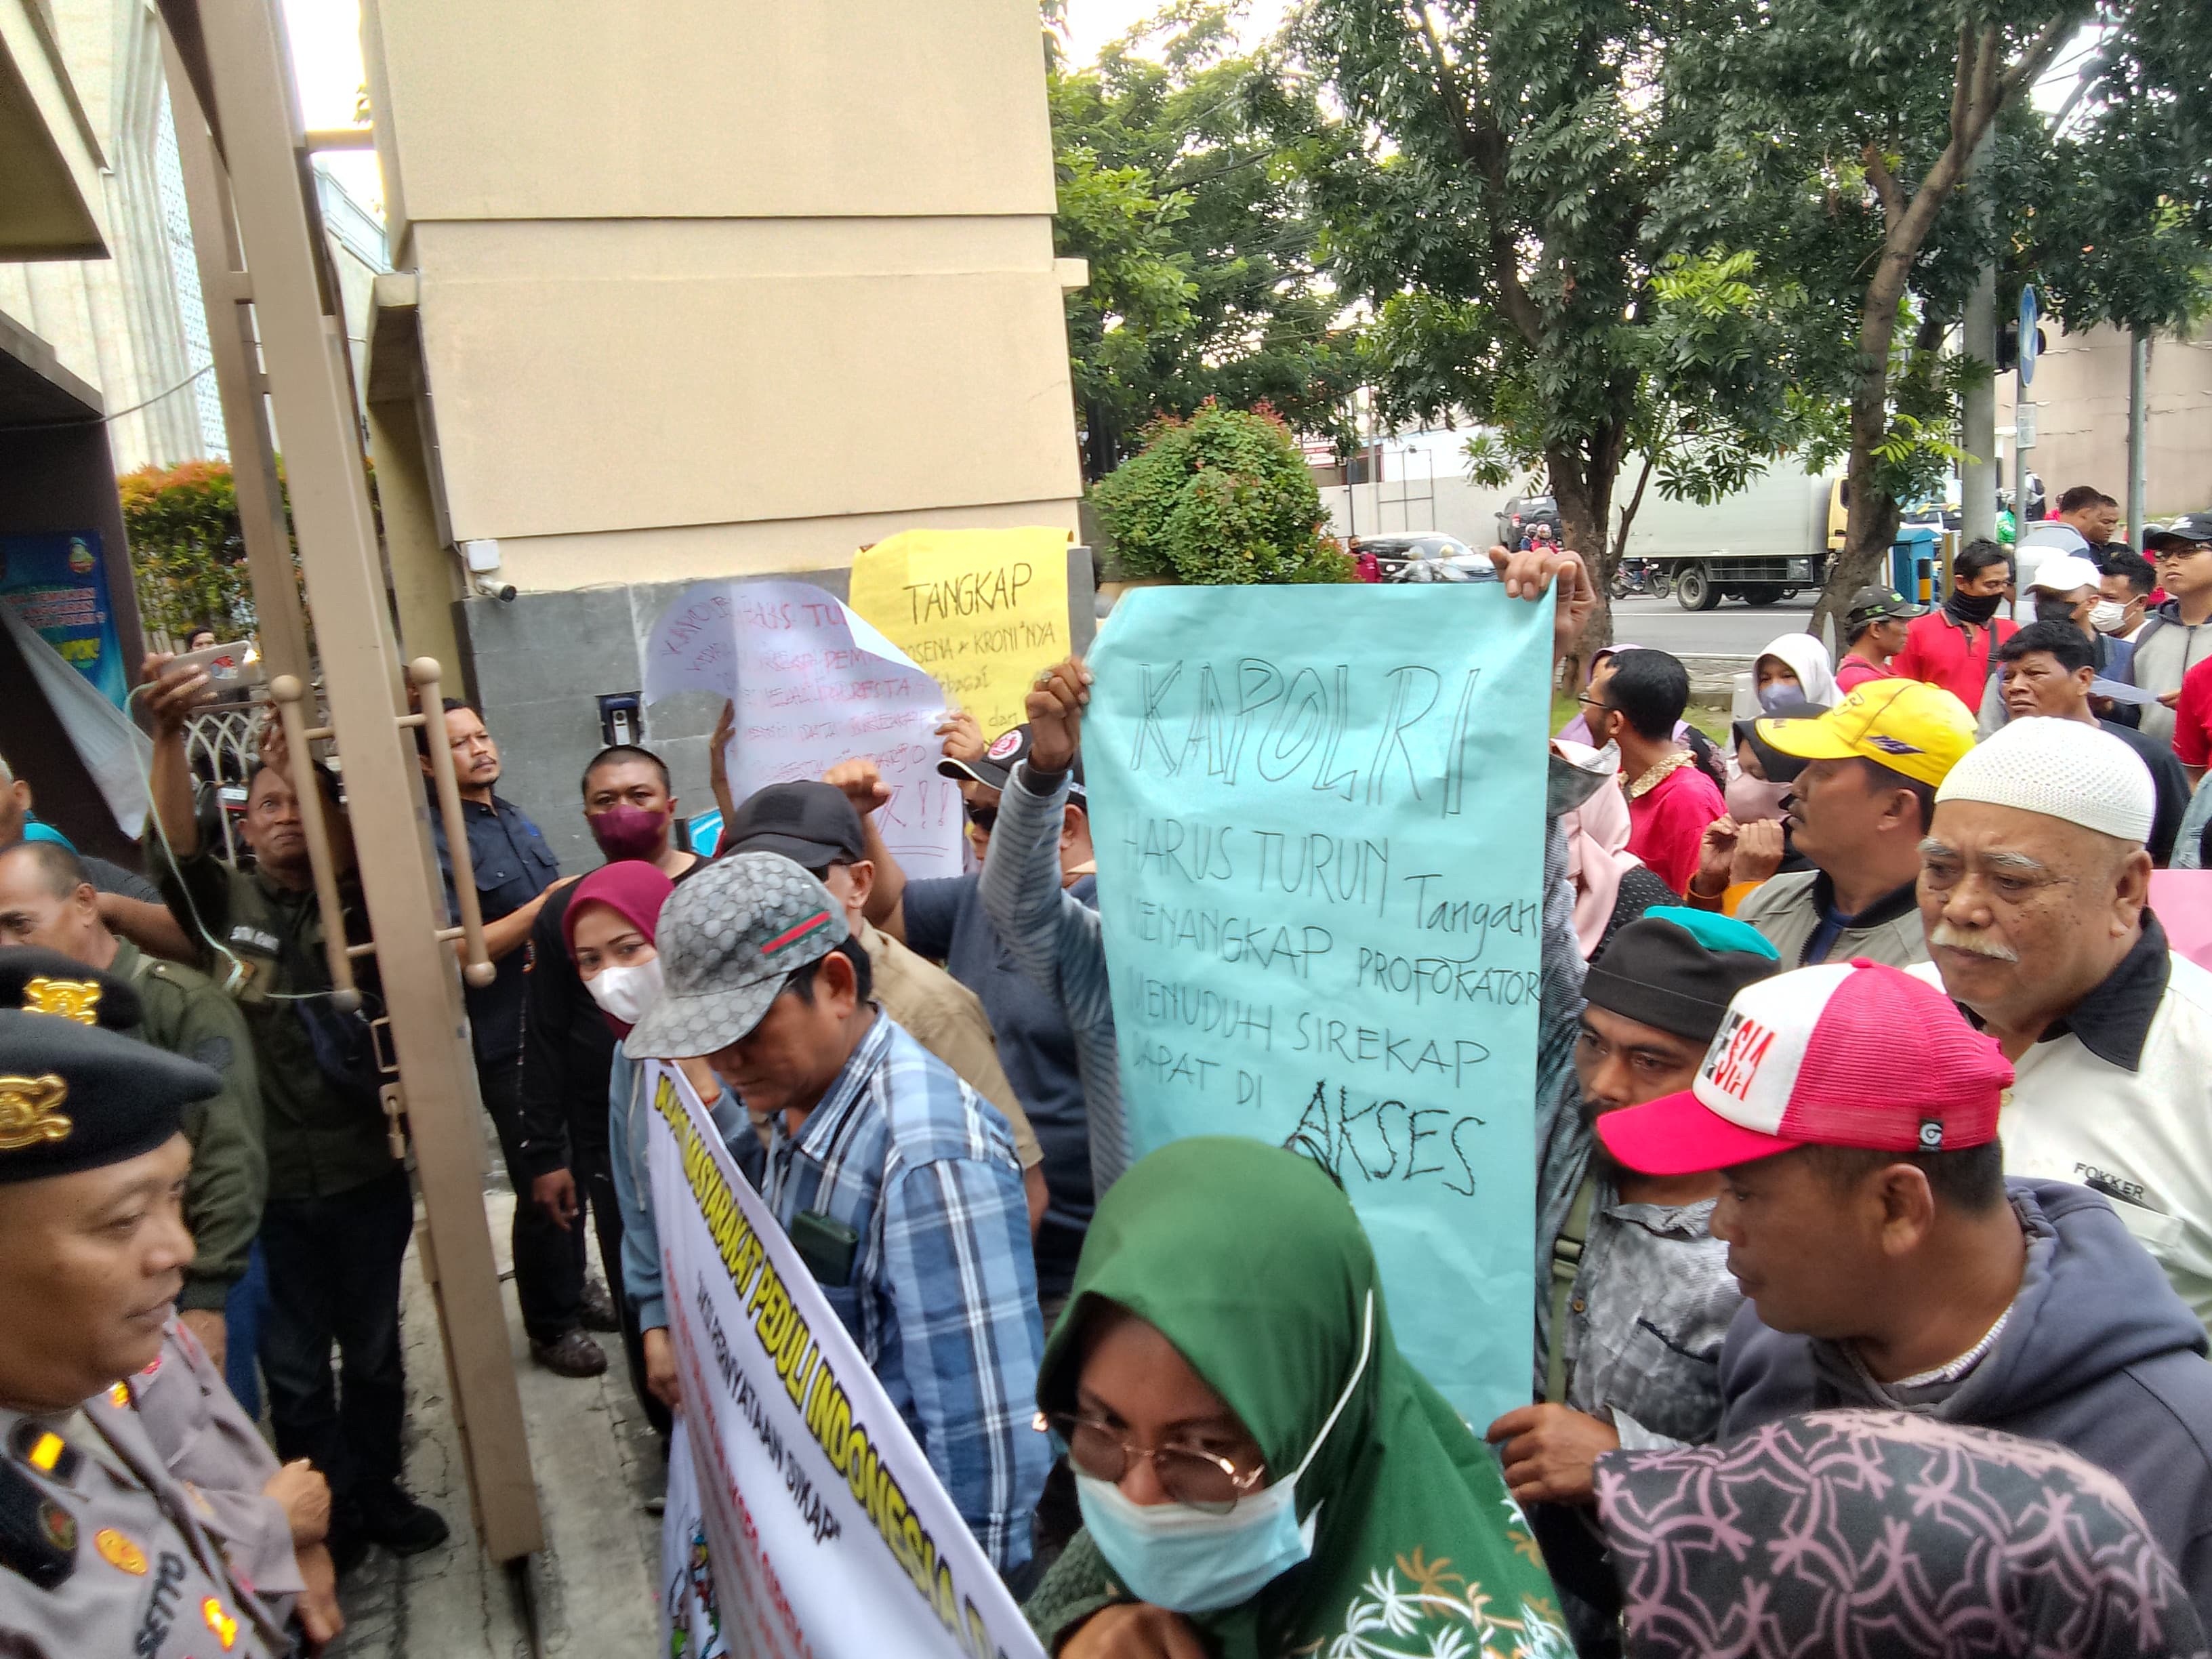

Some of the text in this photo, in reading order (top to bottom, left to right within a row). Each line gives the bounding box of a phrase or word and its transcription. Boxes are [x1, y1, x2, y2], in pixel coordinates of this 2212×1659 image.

[902, 562, 1033, 625] TANGKAP
[1130, 657, 1480, 818] KAPOLRI
[1252, 829, 1389, 918] TURUN
[1403, 874, 1538, 963] Tangan
[1357, 946, 1542, 1006] PROFOKATOR
[1293, 1011, 1490, 1088] SIREKAP
[1237, 1069, 1263, 1109] DI
[1279, 1079, 1486, 1197] AKSES
[2074, 1162, 2144, 1200] FOKKER
[745, 1254, 819, 1415] PEDULI
